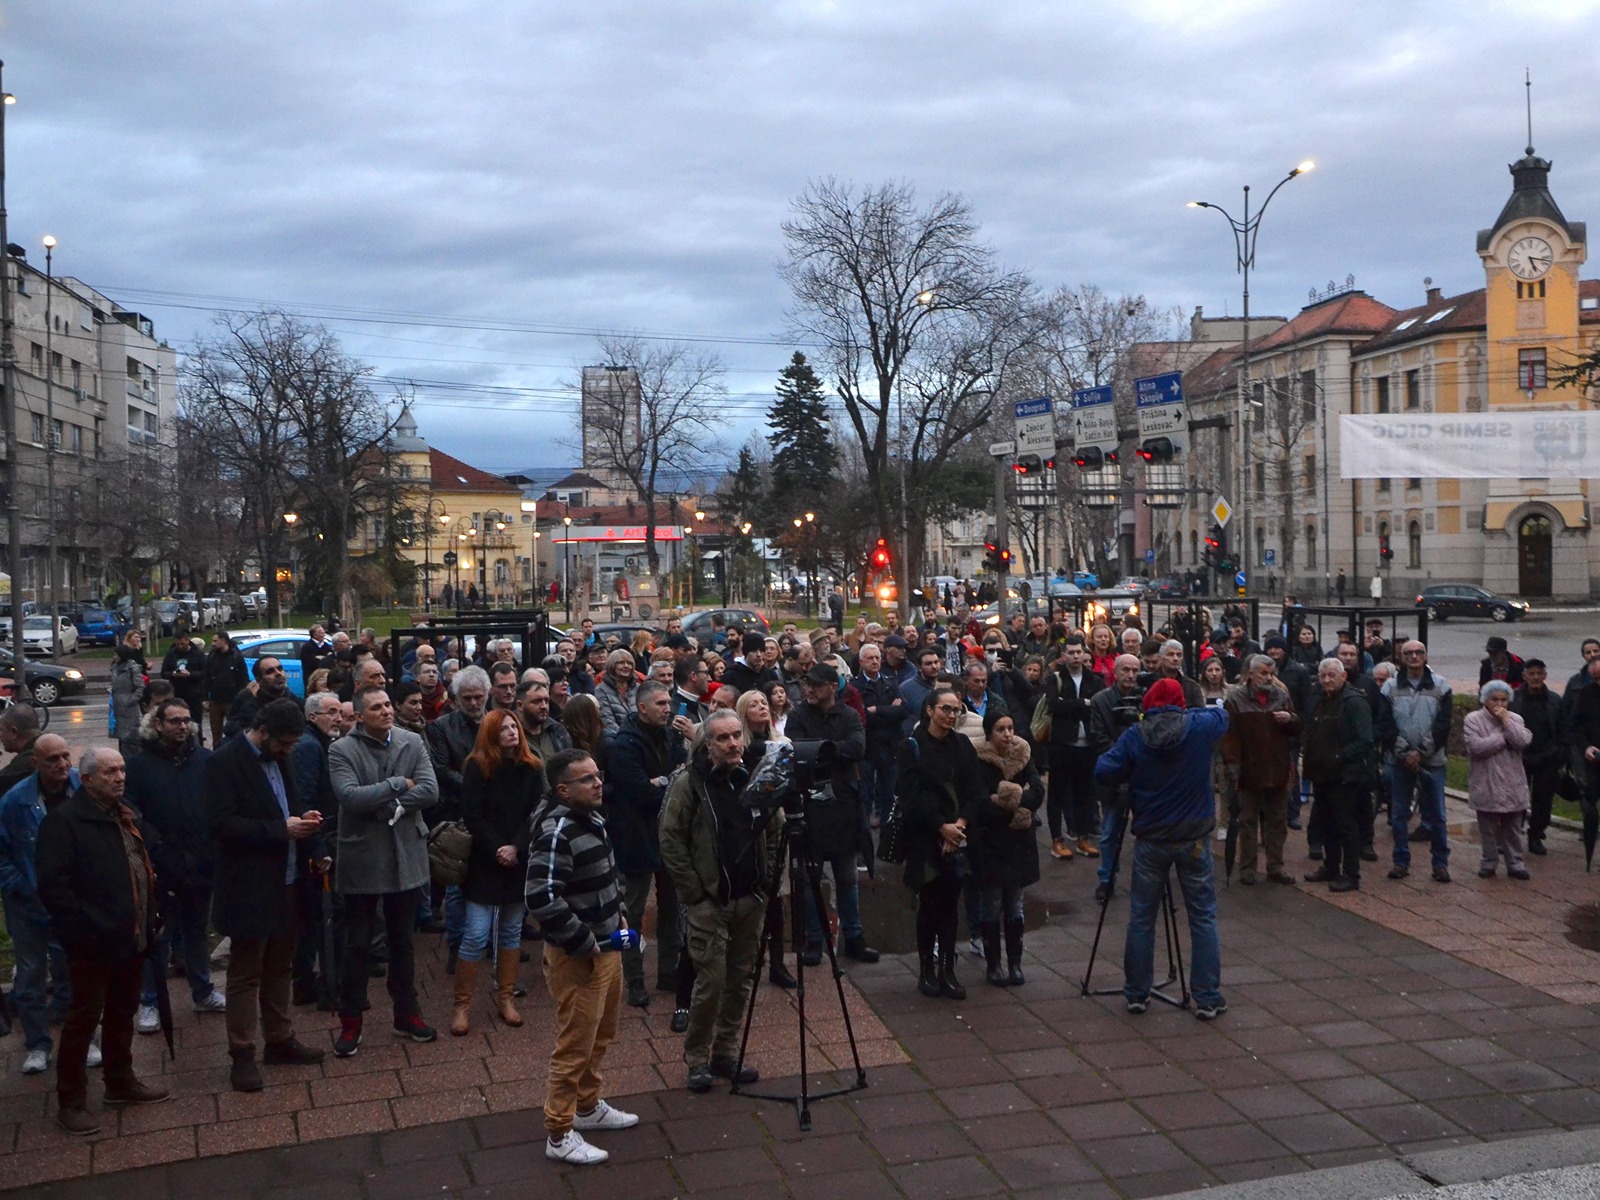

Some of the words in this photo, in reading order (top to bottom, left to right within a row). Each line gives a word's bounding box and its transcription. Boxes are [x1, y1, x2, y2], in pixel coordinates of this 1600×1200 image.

[1139, 382, 1156, 392] Atina
[1140, 392, 1164, 403] Skopje
[1024, 403, 1046, 413] Beograd
[1141, 408, 1167, 419] Priština
[1143, 421, 1173, 432] Leskovac
[1027, 435, 1052, 444] Aleksinac
[623, 528, 640, 537] Art
[642, 527, 673, 537] Ptrol
